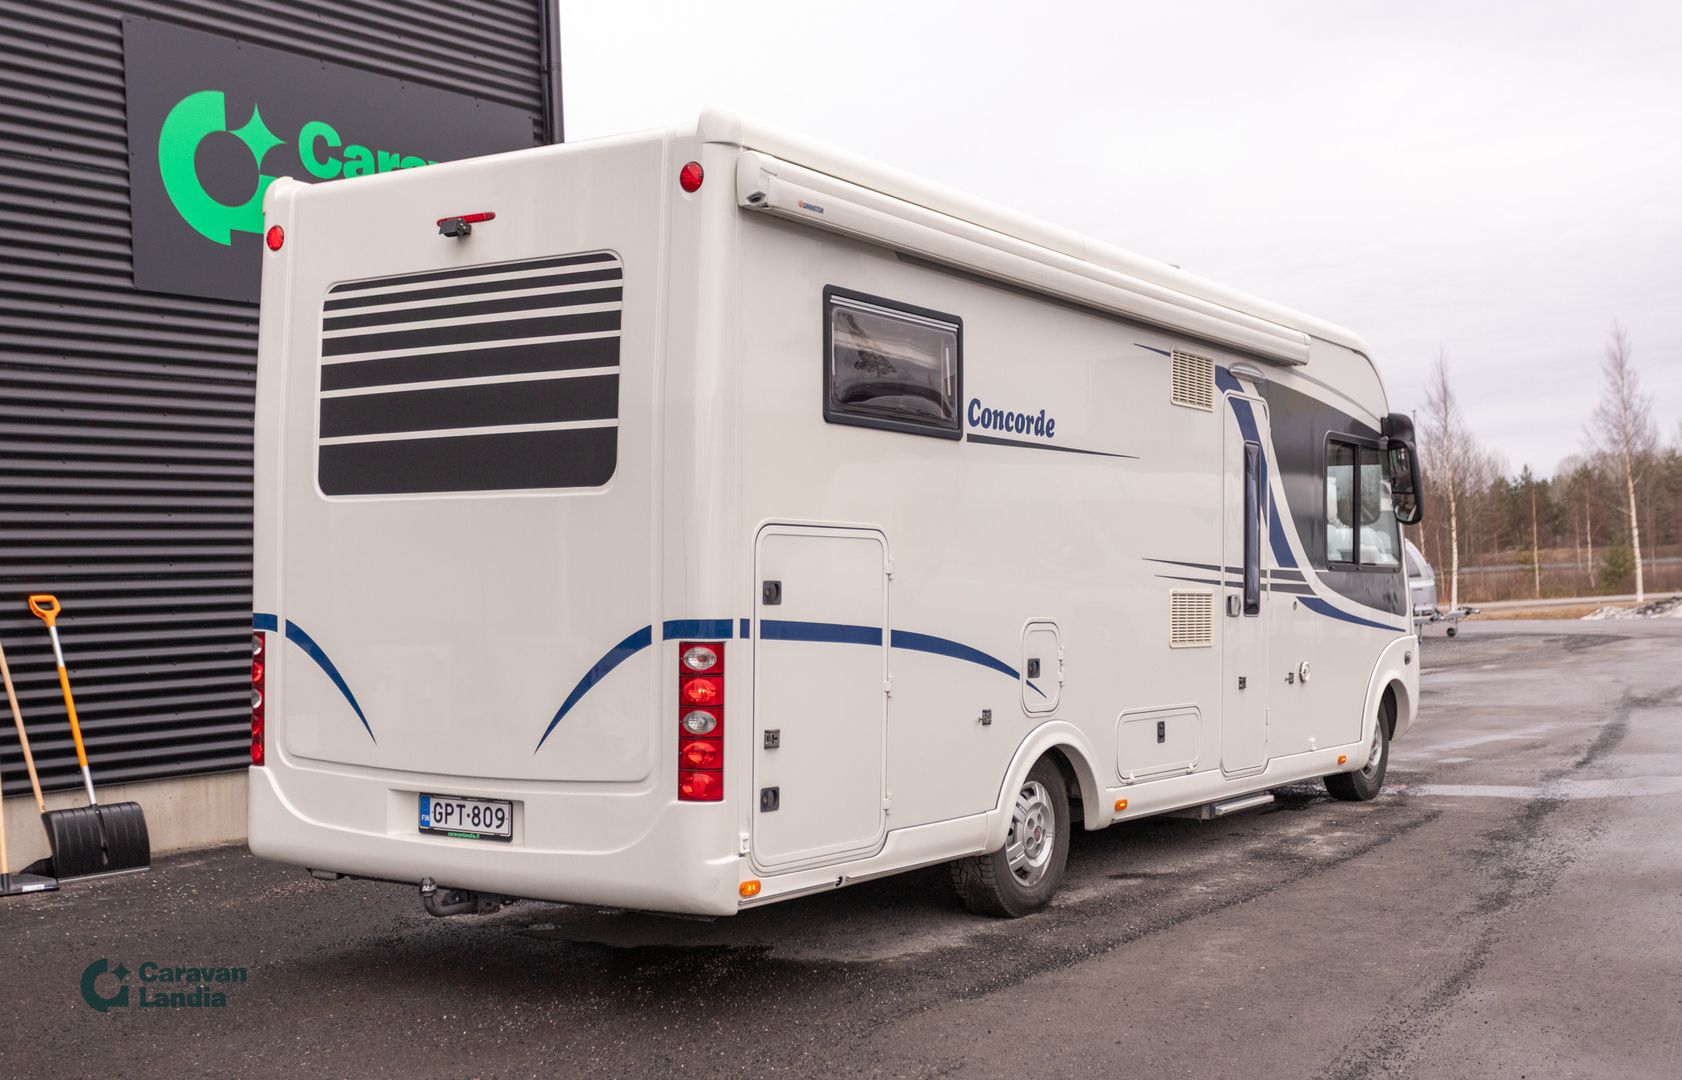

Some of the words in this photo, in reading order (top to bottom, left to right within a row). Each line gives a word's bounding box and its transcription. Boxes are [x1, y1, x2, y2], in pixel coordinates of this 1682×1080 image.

[298, 120, 441, 179] Car
[967, 397, 1056, 439] Concorde
[433, 802, 506, 829] GPT-809
